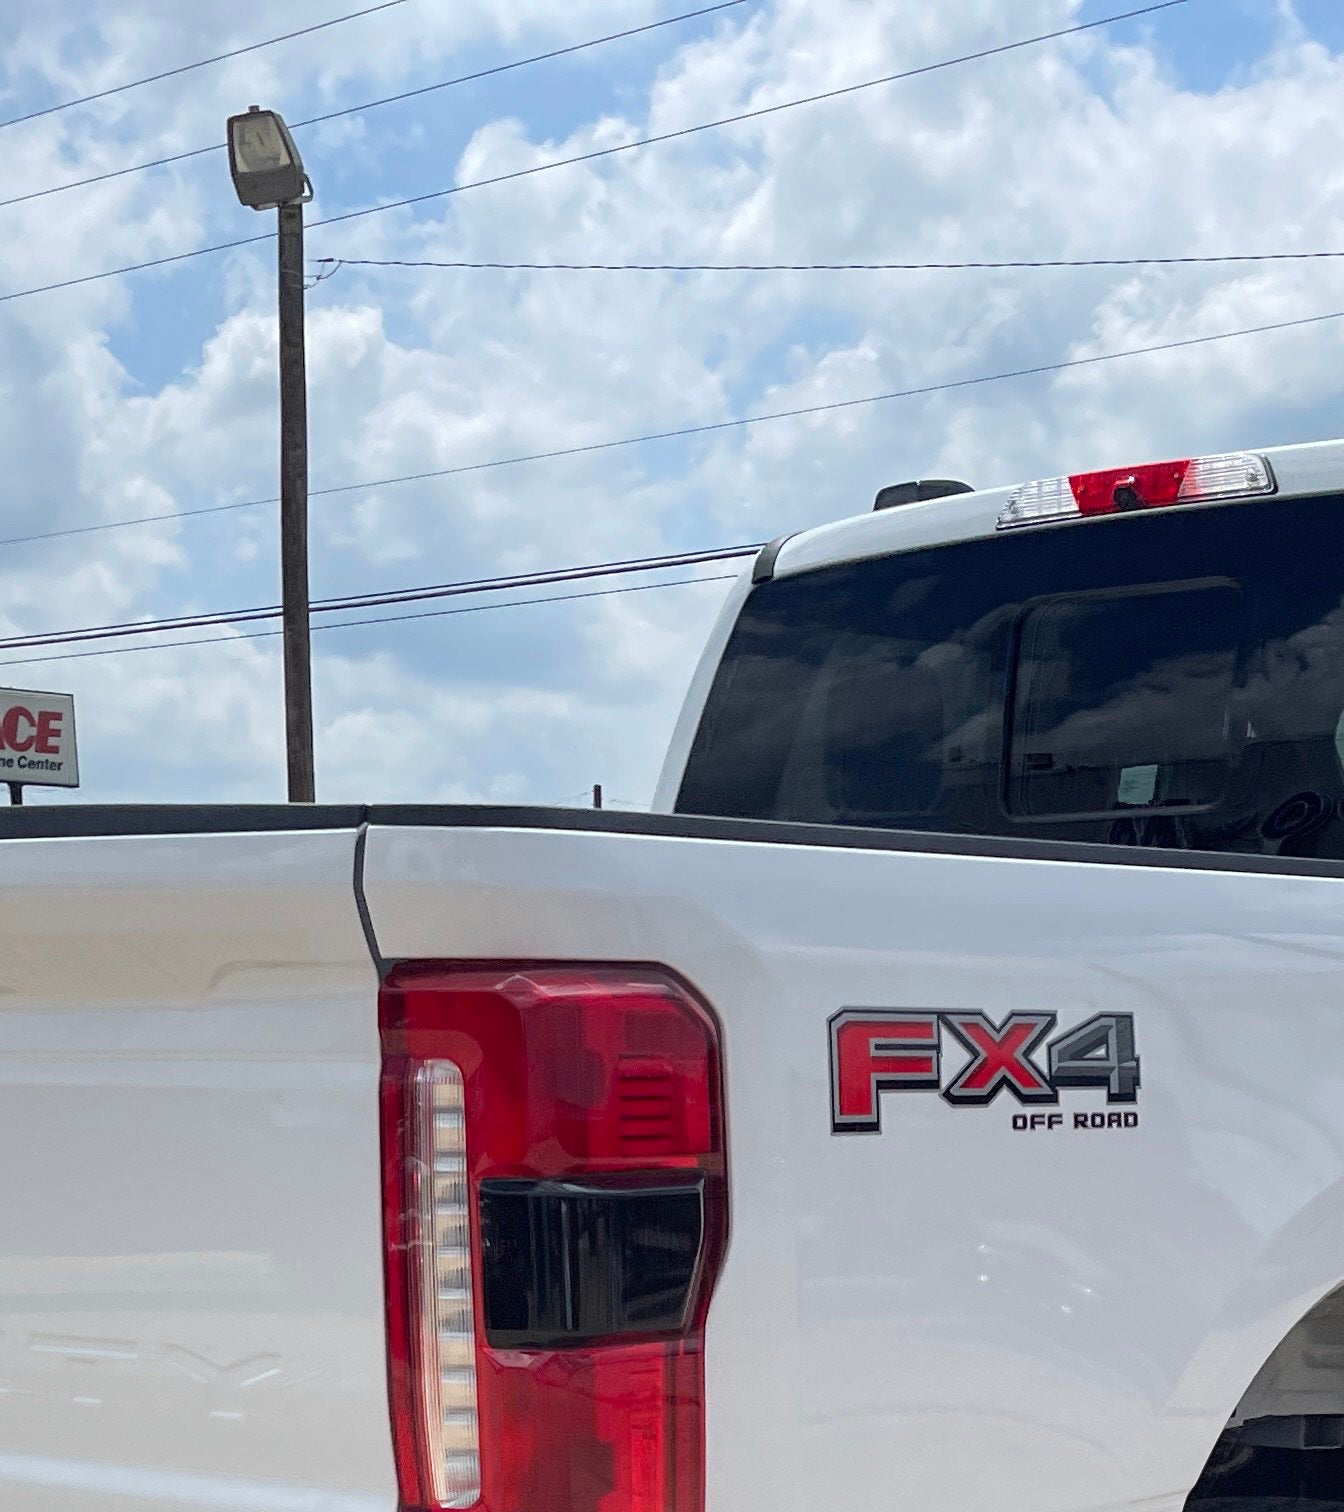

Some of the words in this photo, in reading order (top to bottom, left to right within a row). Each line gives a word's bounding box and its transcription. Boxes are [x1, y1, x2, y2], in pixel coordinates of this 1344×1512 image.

[17, 755, 64, 772] Center
[827, 1005, 1142, 1136] FX4
[1012, 1113, 1064, 1131] OFF
[1073, 1111, 1139, 1129] ROAD
